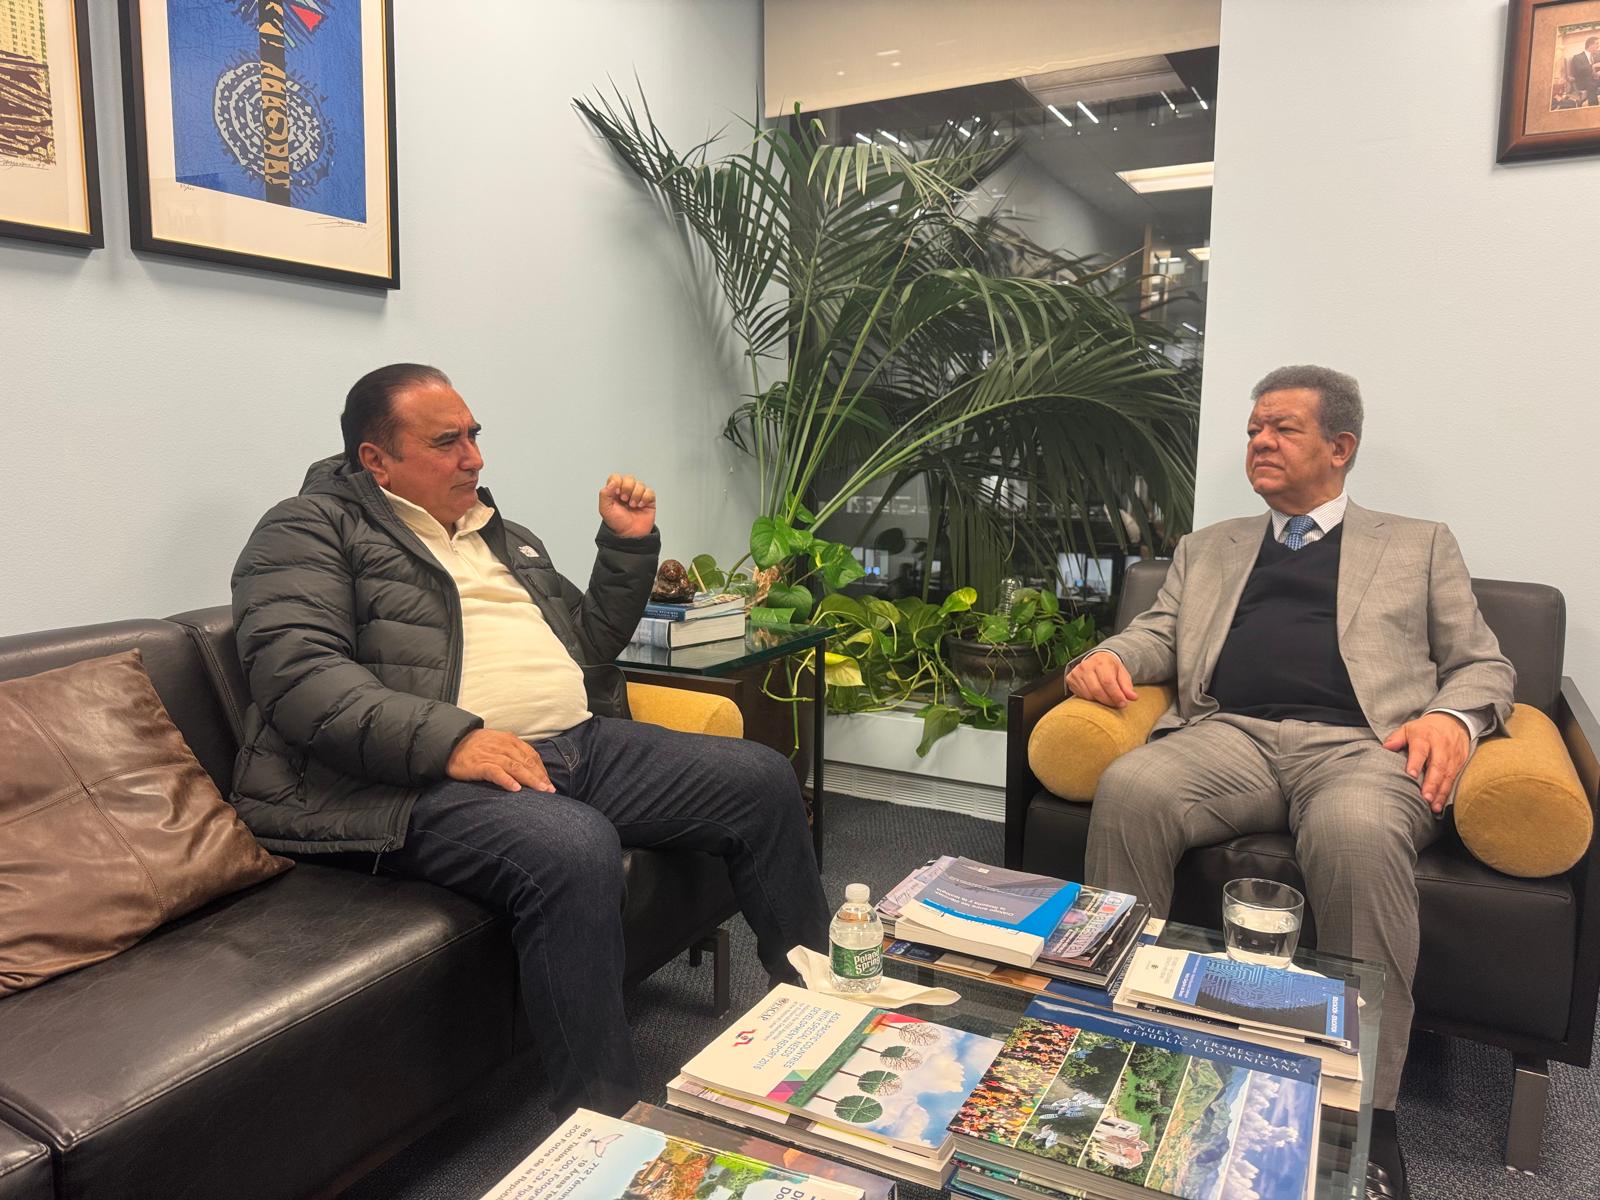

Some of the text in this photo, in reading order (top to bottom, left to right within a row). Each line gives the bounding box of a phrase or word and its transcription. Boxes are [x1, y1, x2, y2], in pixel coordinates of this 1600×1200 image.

[854, 946, 880, 964] Poland
[856, 956, 880, 975] Spring
[788, 1006, 821, 1039] DEVELOPMENT
[1137, 1024, 1189, 1041] NUEVAS
[767, 1039, 789, 1060] REPORT
[781, 1040, 801, 1058] NEEDS
[783, 1040, 814, 1069] COUNTRIES
[1205, 1046, 1300, 1074] DOMINICANA
[564, 1124, 581, 1138] 200
[543, 1138, 567, 1157] Fotos
[554, 1141, 579, 1162] Tablas
[533, 1158, 545, 1167] de
[577, 1159, 589, 1168] 19
[584, 1162, 600, 1176] 712
[774, 1186, 792, 1200] Do
